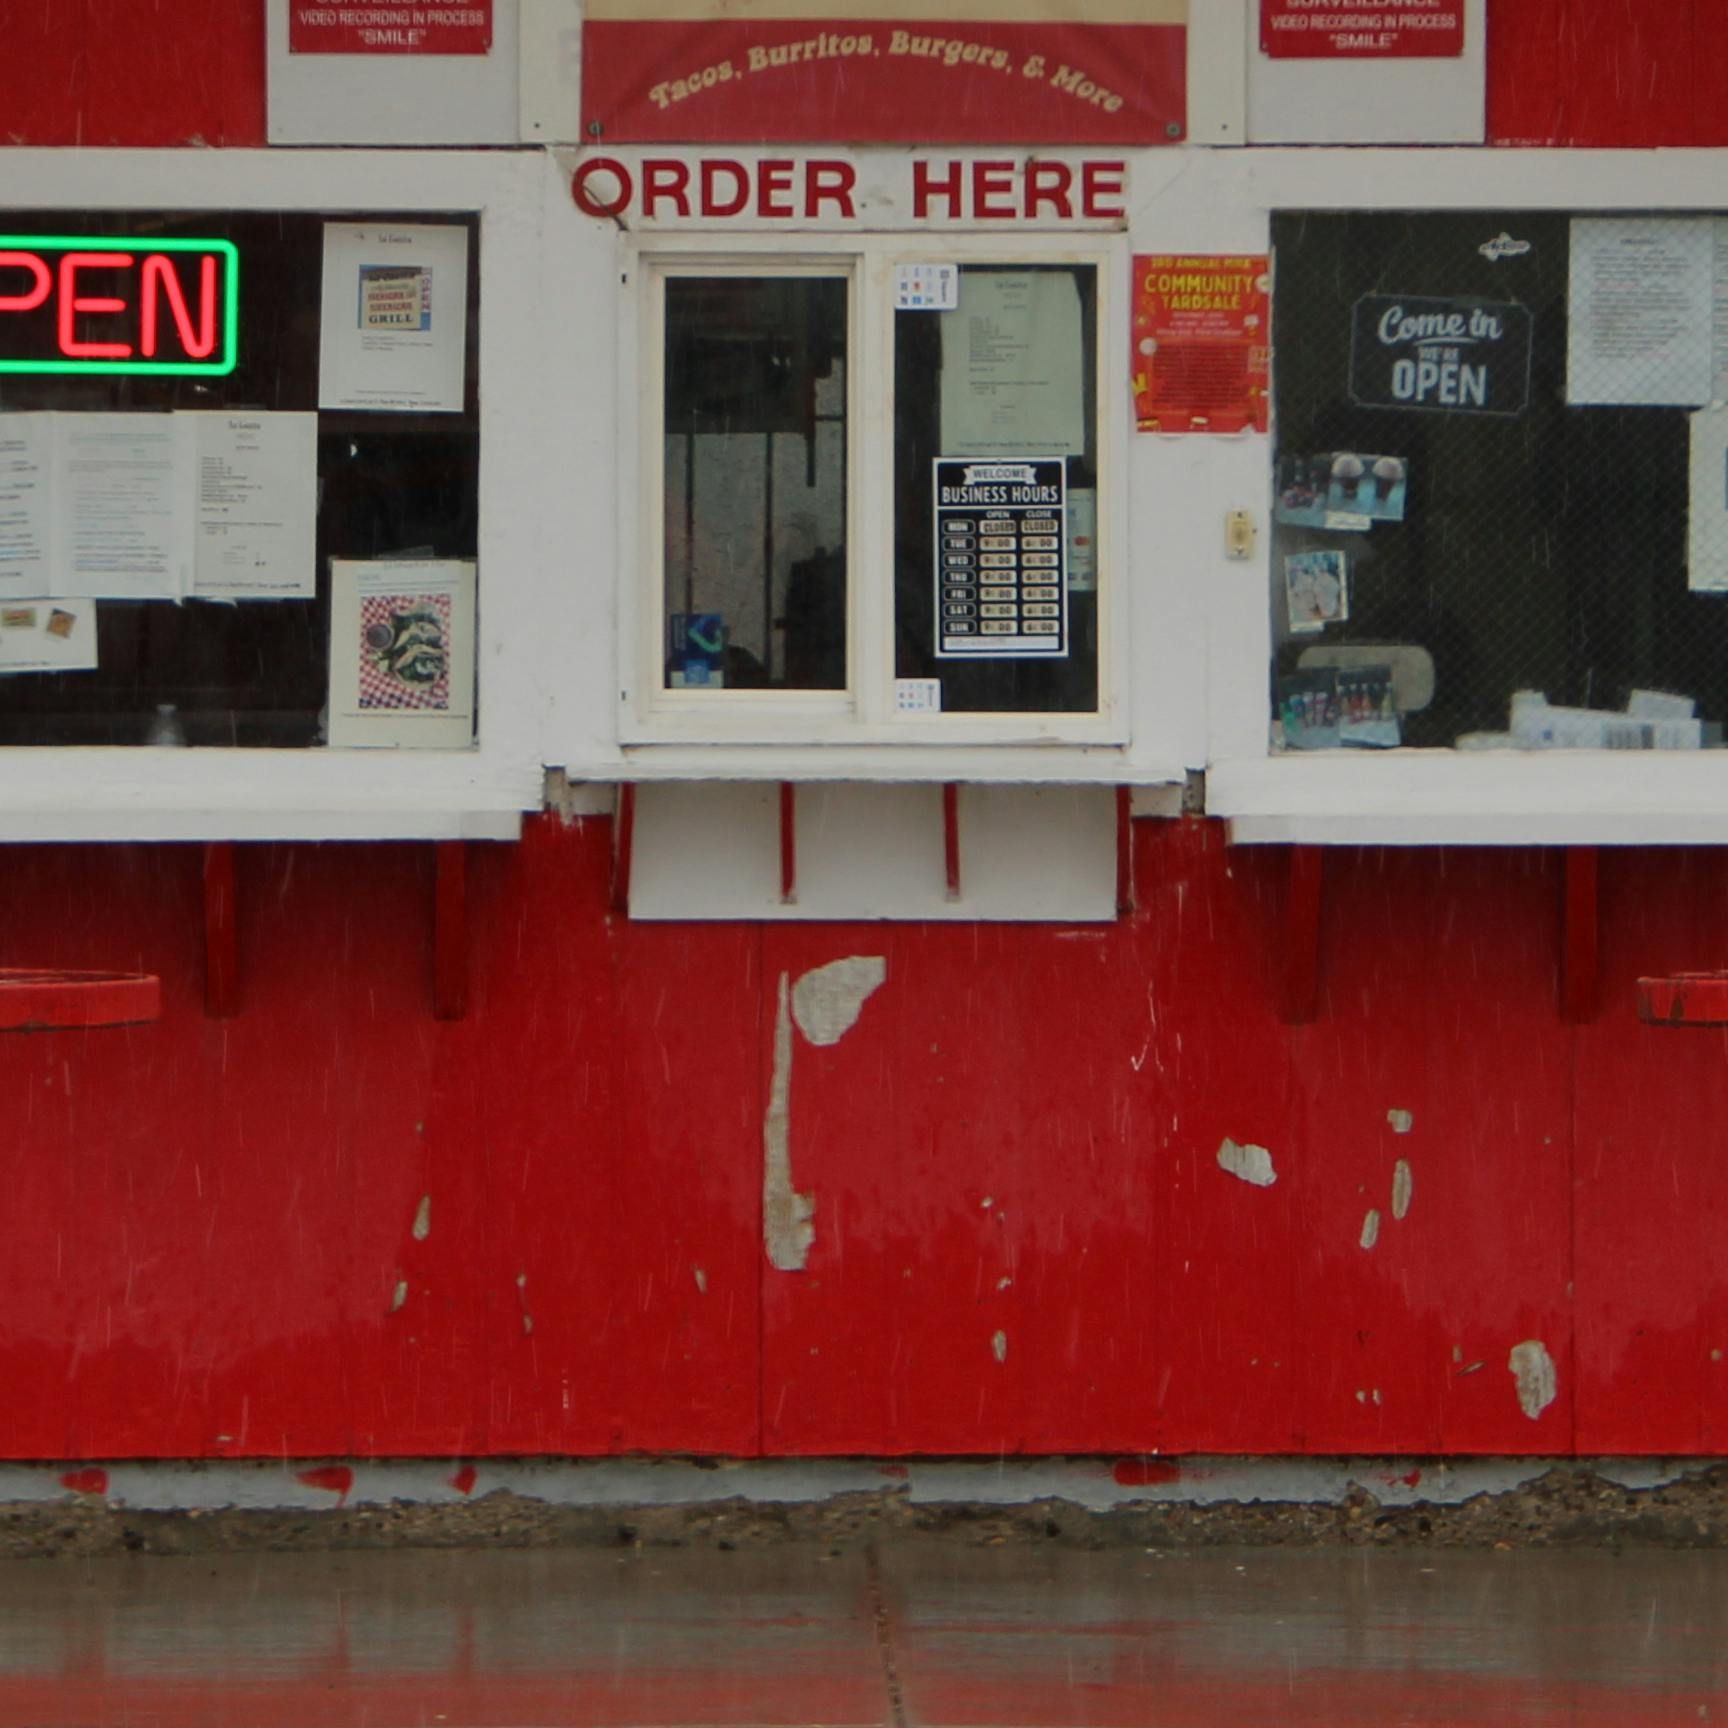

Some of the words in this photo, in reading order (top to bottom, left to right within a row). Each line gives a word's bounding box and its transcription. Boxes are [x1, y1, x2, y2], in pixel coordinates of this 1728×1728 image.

[299, 10, 337, 26] VIDEO
[339, 10, 409, 26] RECORDING
[413, 10, 424, 25] IN
[427, 10, 484, 26] PROCESS
[1271, 14, 1308, 30] VIDEO
[1310, 14, 1381, 30] RECORDING
[1384, 14, 1396, 29] IN
[1399, 14, 1456, 29] PROCESS
[358, 29, 426, 45] "SMILE"
[1330, 33, 1398, 49] "SMILE"
[649, 58, 743, 110] Tacos,
[748, 32, 881, 72] Burritos,
[888, 29, 1013, 74] Burgers,
[1022, 55, 1044, 79] &
[1050, 64, 1124, 113] More
[573, 157, 857, 219] ORDER
[912, 159, 1126, 220] HERE
[1145, 274, 1253, 293] COMMUNITY
[1162, 294, 1241, 309] YARDSALE
[368, 314, 414, 324] GRILL
[1378, 306, 1466, 344] Come
[1470, 308, 1503, 340] in
[1392, 359, 1487, 405] OPEN
[973, 468, 1026, 479] WELCOME
[942, 486, 1007, 503] BUSINESS
[1012, 486, 1058, 502] HOURS
[986, 511, 1010, 519] OPEN
[1026, 510, 1052, 518] CLOSE
[983, 521, 1016, 532] CLOSED
[1024, 520, 1055, 531] CLOSED
[948, 556, 969, 565] WED
[949, 605, 968, 615] SAT
[949, 623, 969, 632] SUN
